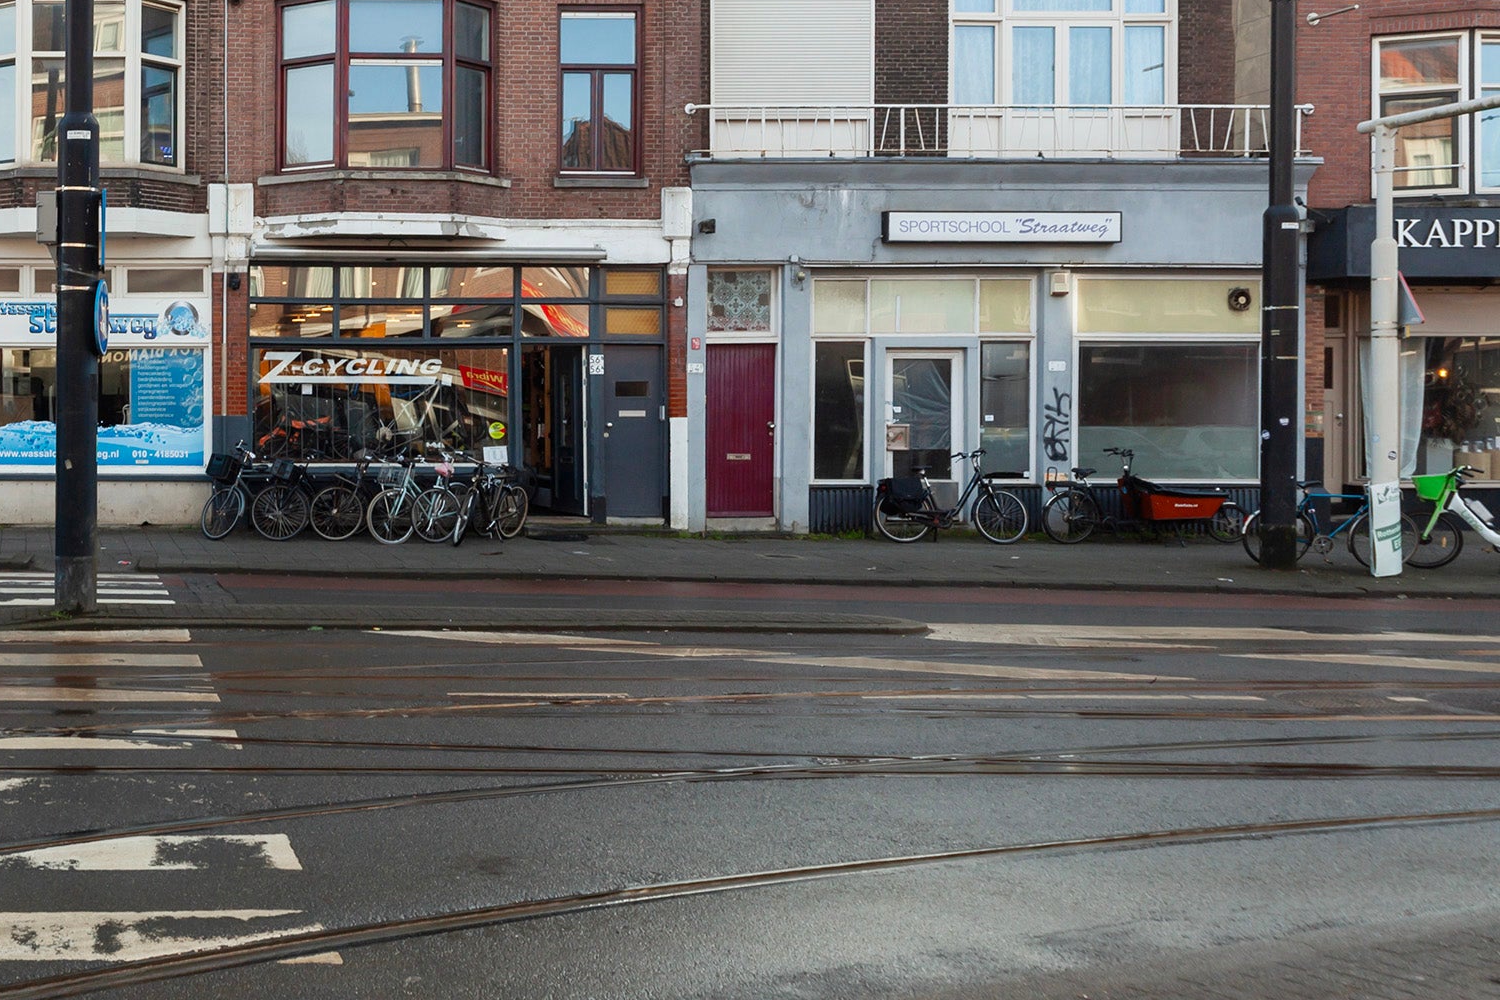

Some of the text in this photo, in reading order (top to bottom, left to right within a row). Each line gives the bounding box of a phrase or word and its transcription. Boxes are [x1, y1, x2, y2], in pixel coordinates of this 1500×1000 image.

[900, 220, 1011, 233] SPORTSCHOOL
[1394, 218, 1500, 248] KAPP
[131, 449, 148, 458] 010
[154, 449, 189, 458] 4185031
